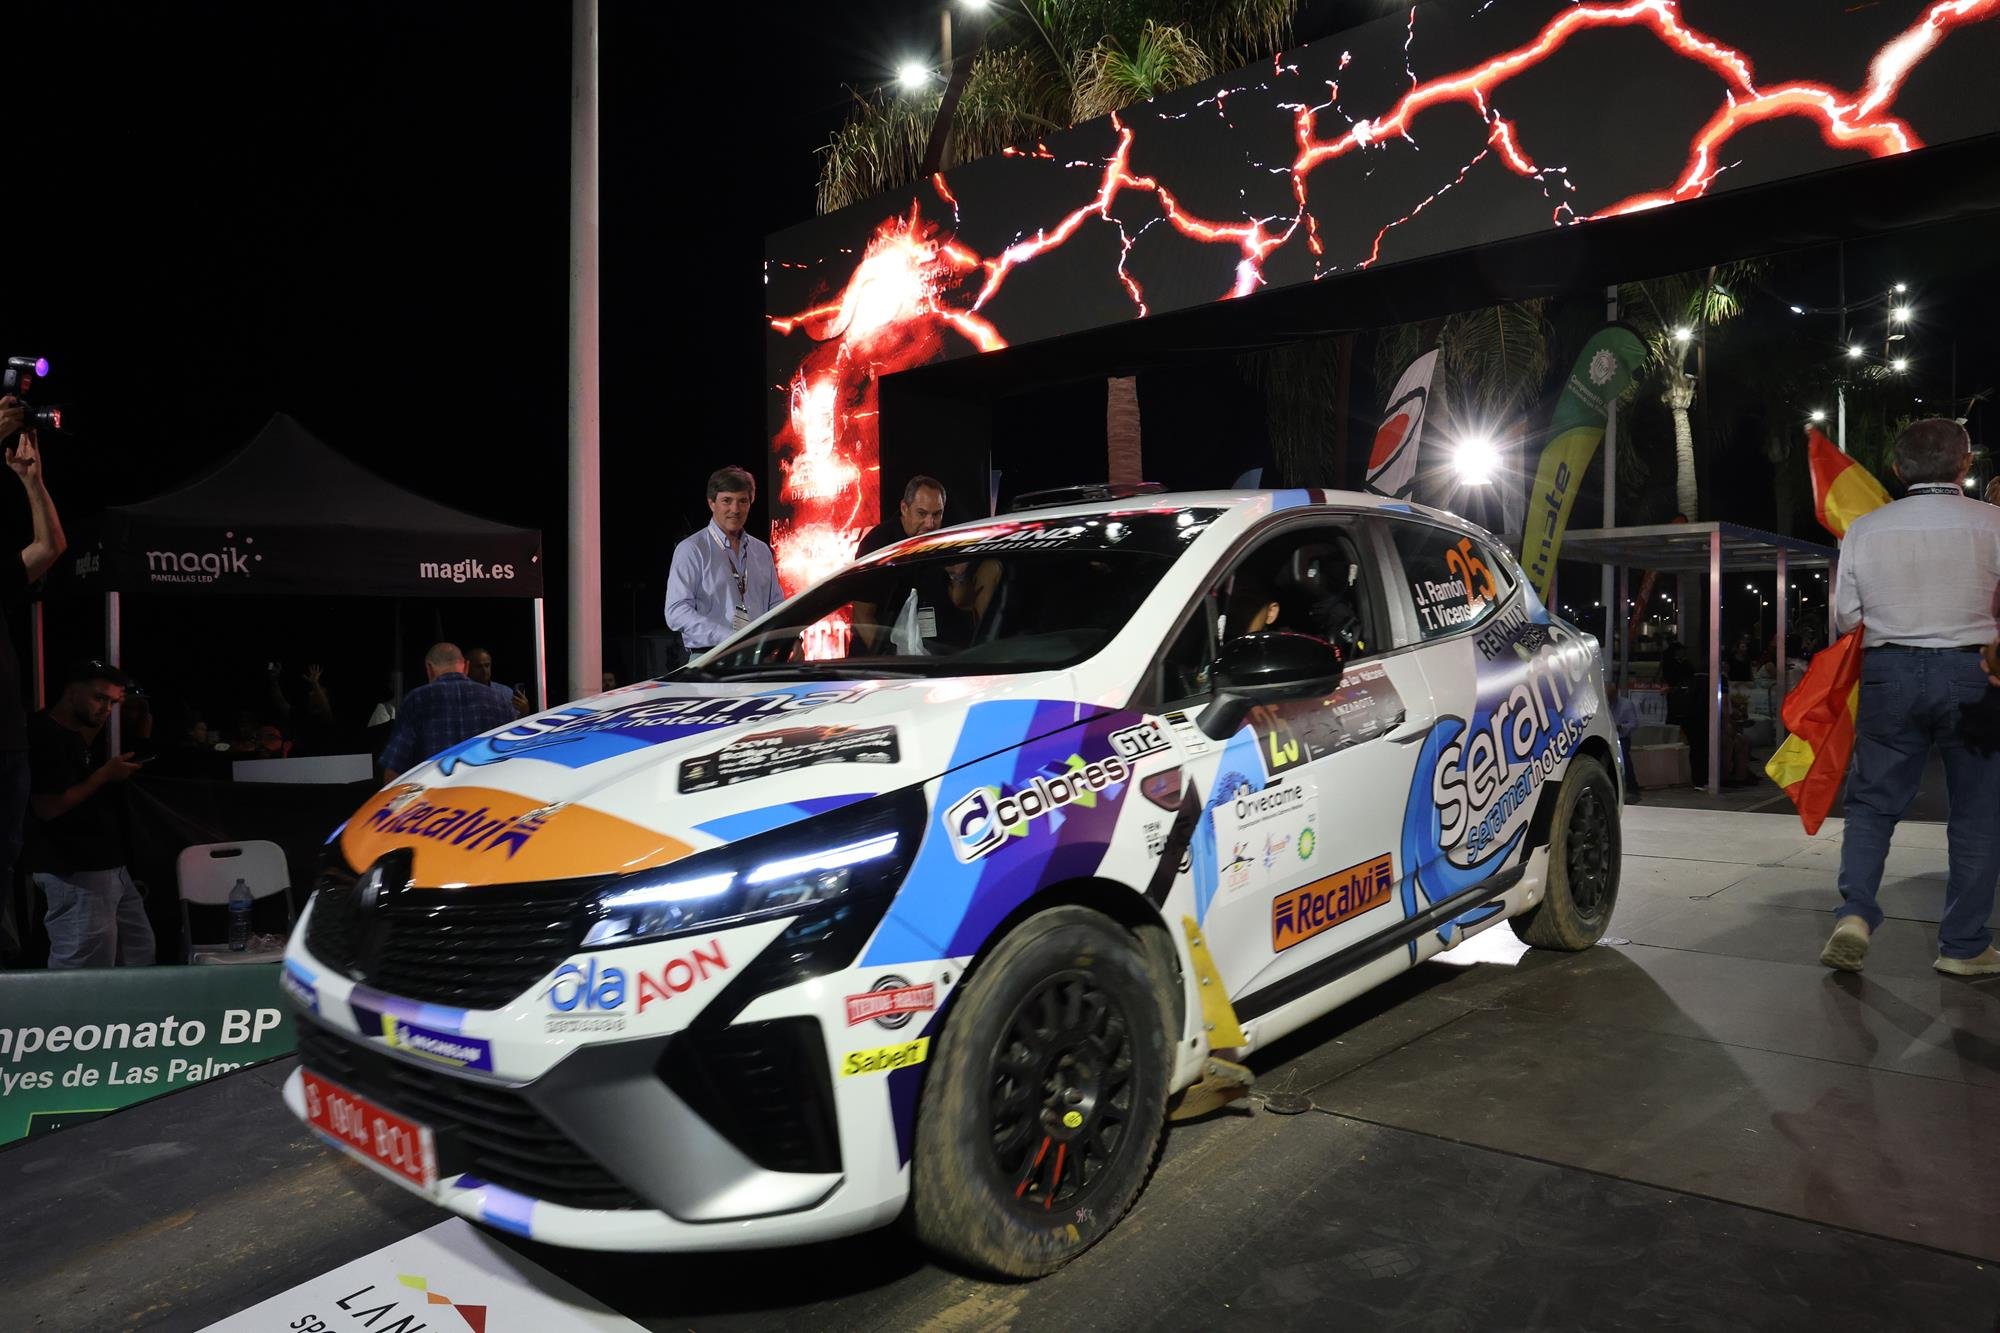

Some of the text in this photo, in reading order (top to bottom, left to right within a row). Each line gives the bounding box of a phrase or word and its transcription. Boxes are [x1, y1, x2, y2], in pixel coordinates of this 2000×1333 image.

[918, 262, 961, 282] Consejo
[146, 546, 249, 579] magik
[151, 574, 213, 583] PANTALLAS LED
[419, 559, 515, 583] magik.es
[1446, 537, 1497, 610] 25
[1414, 575, 1468, 606] J. Ramón
[1420, 603, 1472, 631] T. Vicens
[1476, 604, 1529, 661] RENAULT
[995, 757, 1126, 828] colores
[1297, 867, 1374, 935] Recalvi
[550, 957, 626, 1011] Ola
[635, 938, 731, 1015] AON
[219, 1008, 282, 1045] BP
[62, 1063, 99, 1088] de
[108, 1061, 159, 1086] Las
